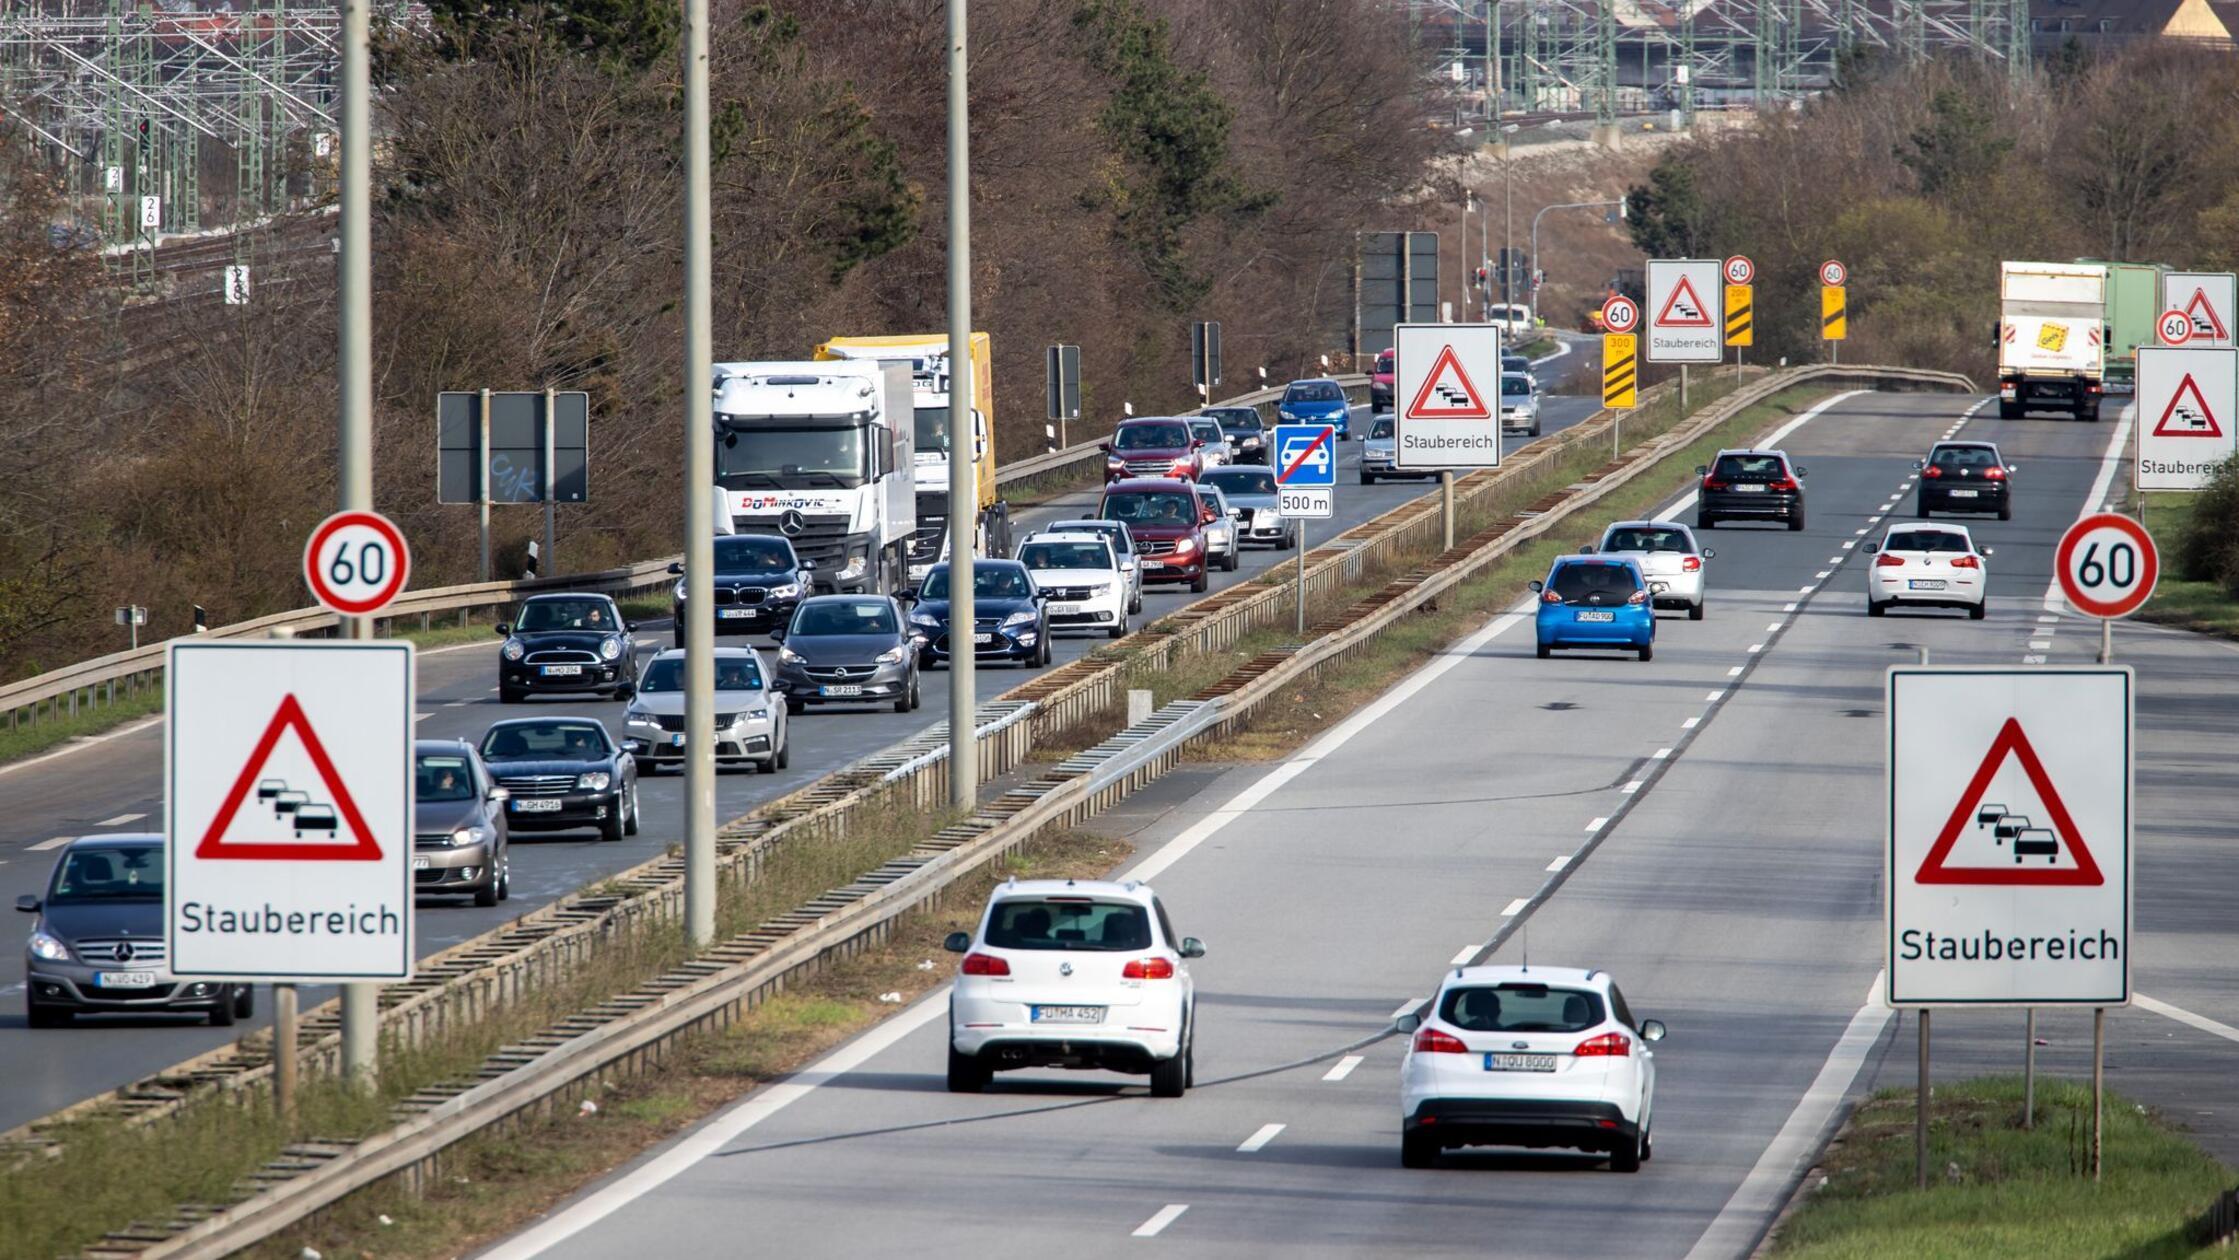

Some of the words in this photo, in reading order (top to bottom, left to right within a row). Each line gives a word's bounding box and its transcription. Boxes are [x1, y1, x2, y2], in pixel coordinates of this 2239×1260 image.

[147, 198, 155, 223] 26
[1731, 264, 1747, 277] 60
[1827, 267, 1841, 280] 60
[1610, 306, 1630, 323] 60
[2166, 320, 2185, 336] 60
[1610, 337, 1630, 348] 300
[1653, 337, 1717, 349] Staubereich
[1404, 434, 1493, 449] Staubereich
[1282, 495, 1310, 510] 500
[1314, 499, 1328, 510] m
[331, 541, 384, 585] 60
[2079, 542, 2135, 588] 60
[181, 902, 399, 935] Staubereich
[1900, 929, 2119, 960] Staubereich
[1039, 1007, 1053, 1018] FU
[1060, 1007, 1074, 1018] MA
[1077, 1008, 1097, 1019] 452
[1508, 1055, 1523, 1066] QU
[1525, 1055, 1554, 1068] 8000
